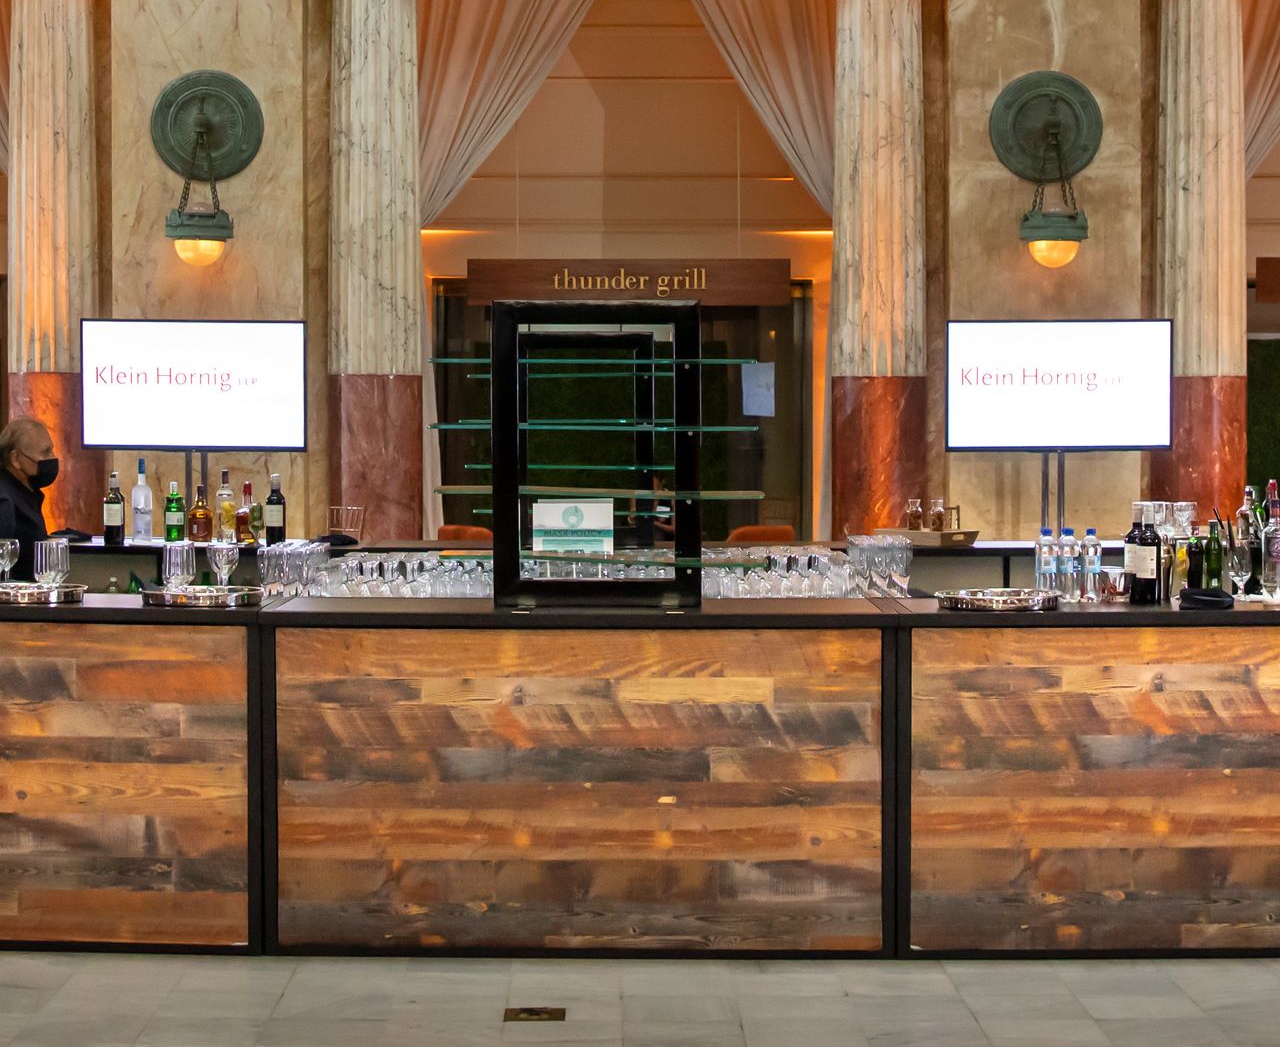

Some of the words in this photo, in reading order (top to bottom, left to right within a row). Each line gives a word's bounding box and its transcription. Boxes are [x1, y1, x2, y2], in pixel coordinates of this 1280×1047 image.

[553, 268, 649, 290] thunder
[656, 268, 708, 298] grill
[95, 365, 148, 385] Klein
[156, 367, 232, 392] Hornig
[961, 366, 1013, 386] Klein
[1022, 367, 1098, 392] Hornig
